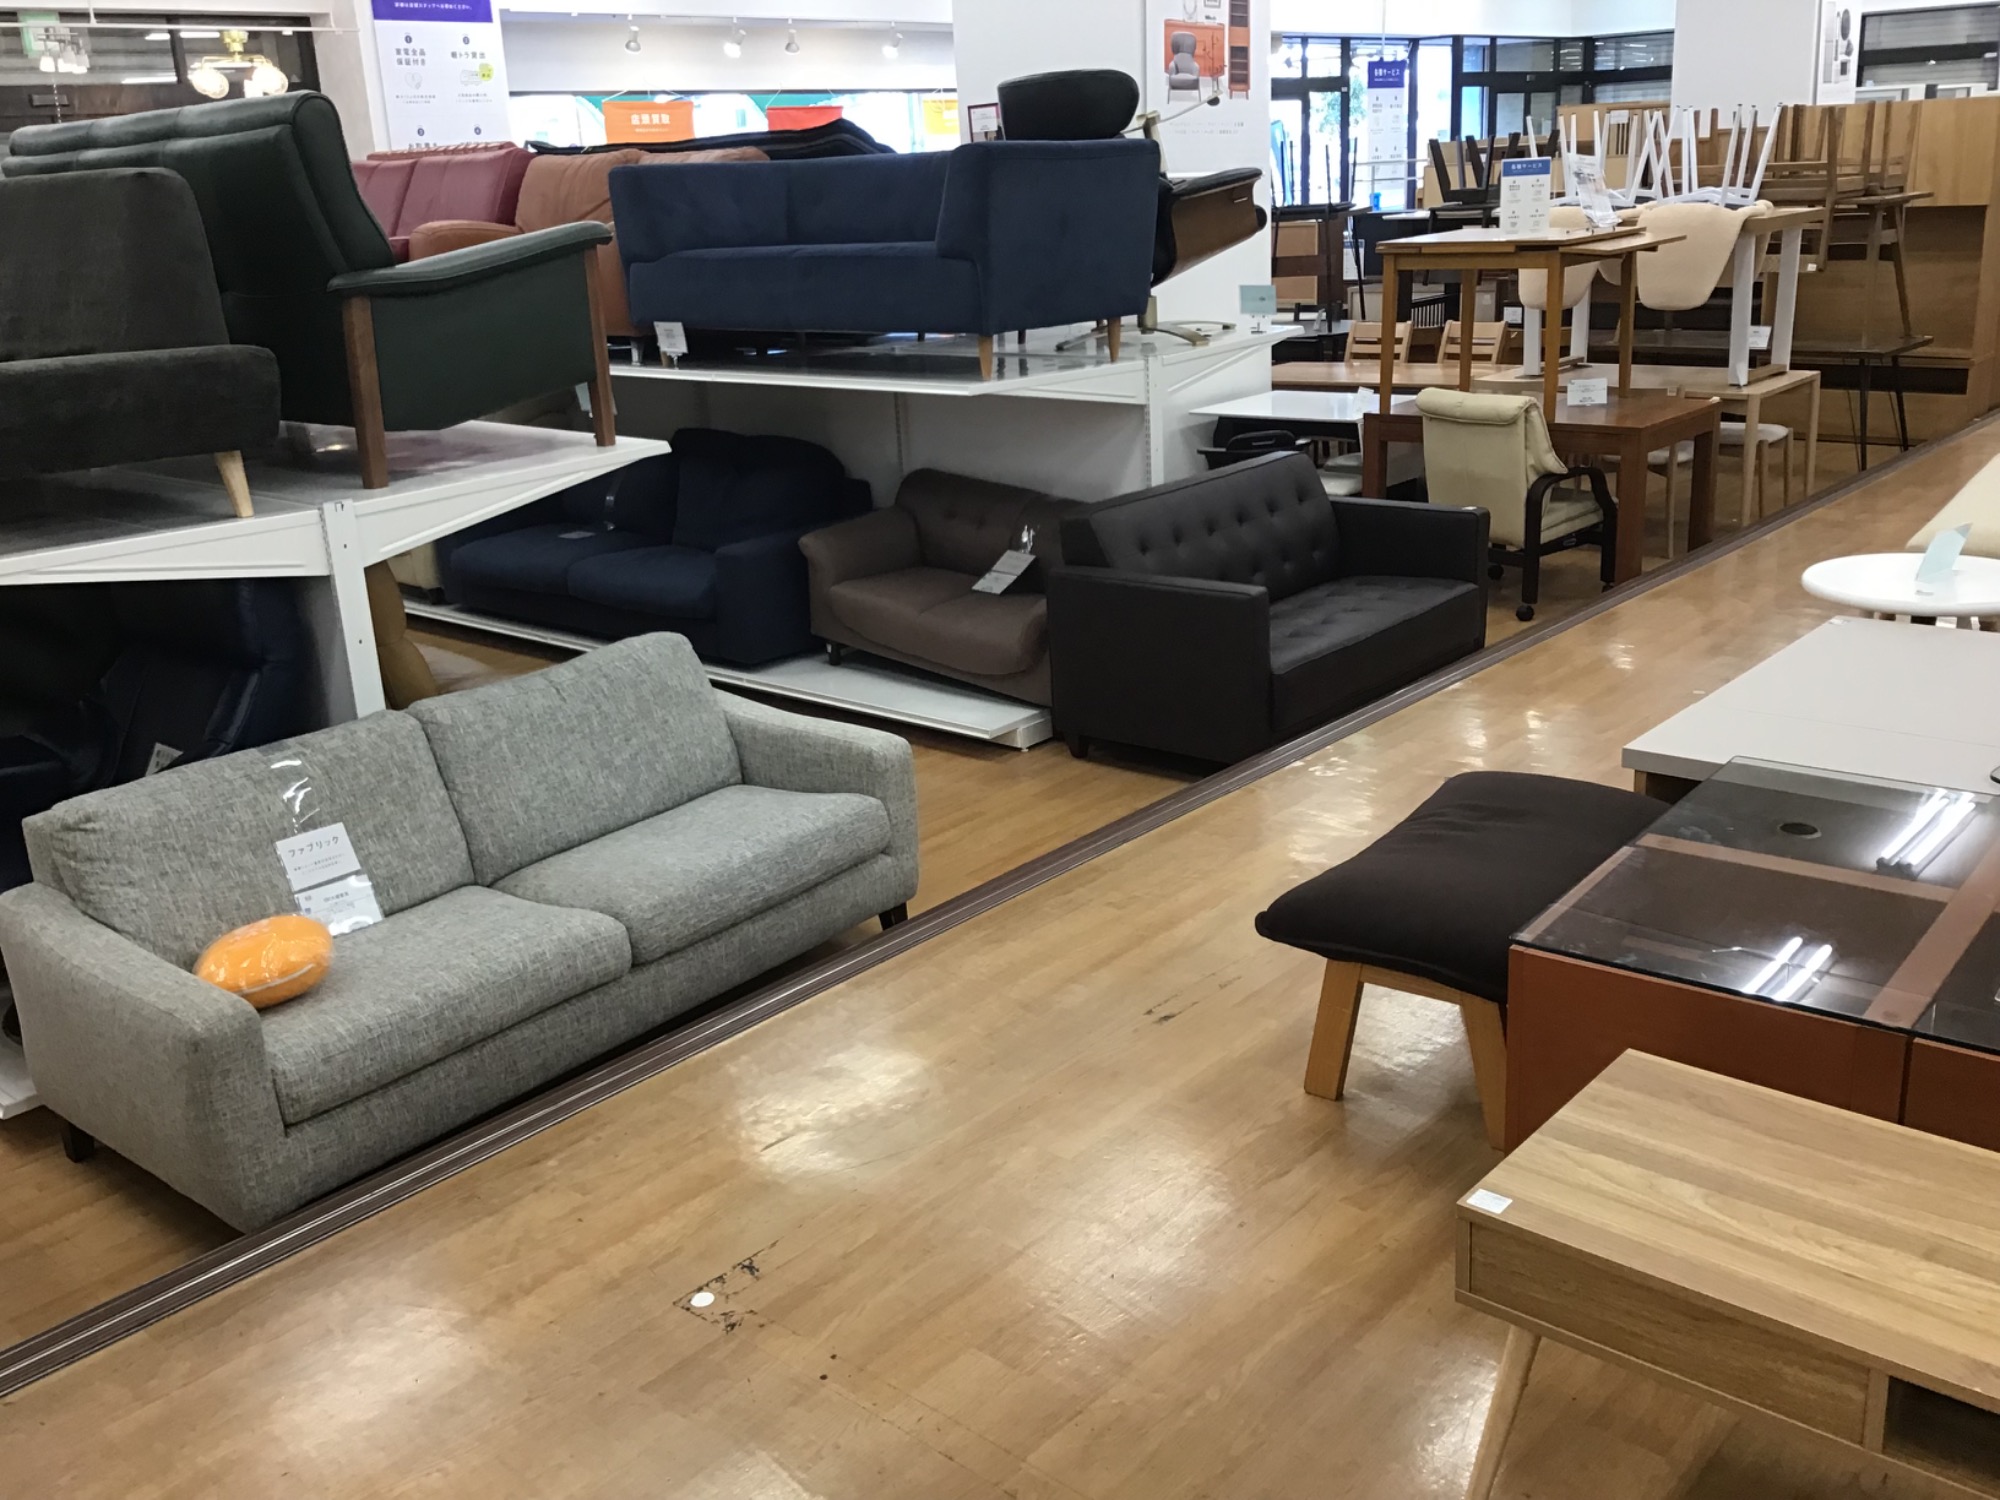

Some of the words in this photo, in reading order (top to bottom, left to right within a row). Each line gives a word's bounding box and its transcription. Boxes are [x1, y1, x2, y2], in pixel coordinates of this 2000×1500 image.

[395, 48, 426, 57] 家電全品
[450, 51, 486, 60] 軽トラ貸出
[396, 57, 426, 66] 保証付き
[630, 113, 671, 125] 店頭買取
[288, 836, 339, 857] ファブリック
